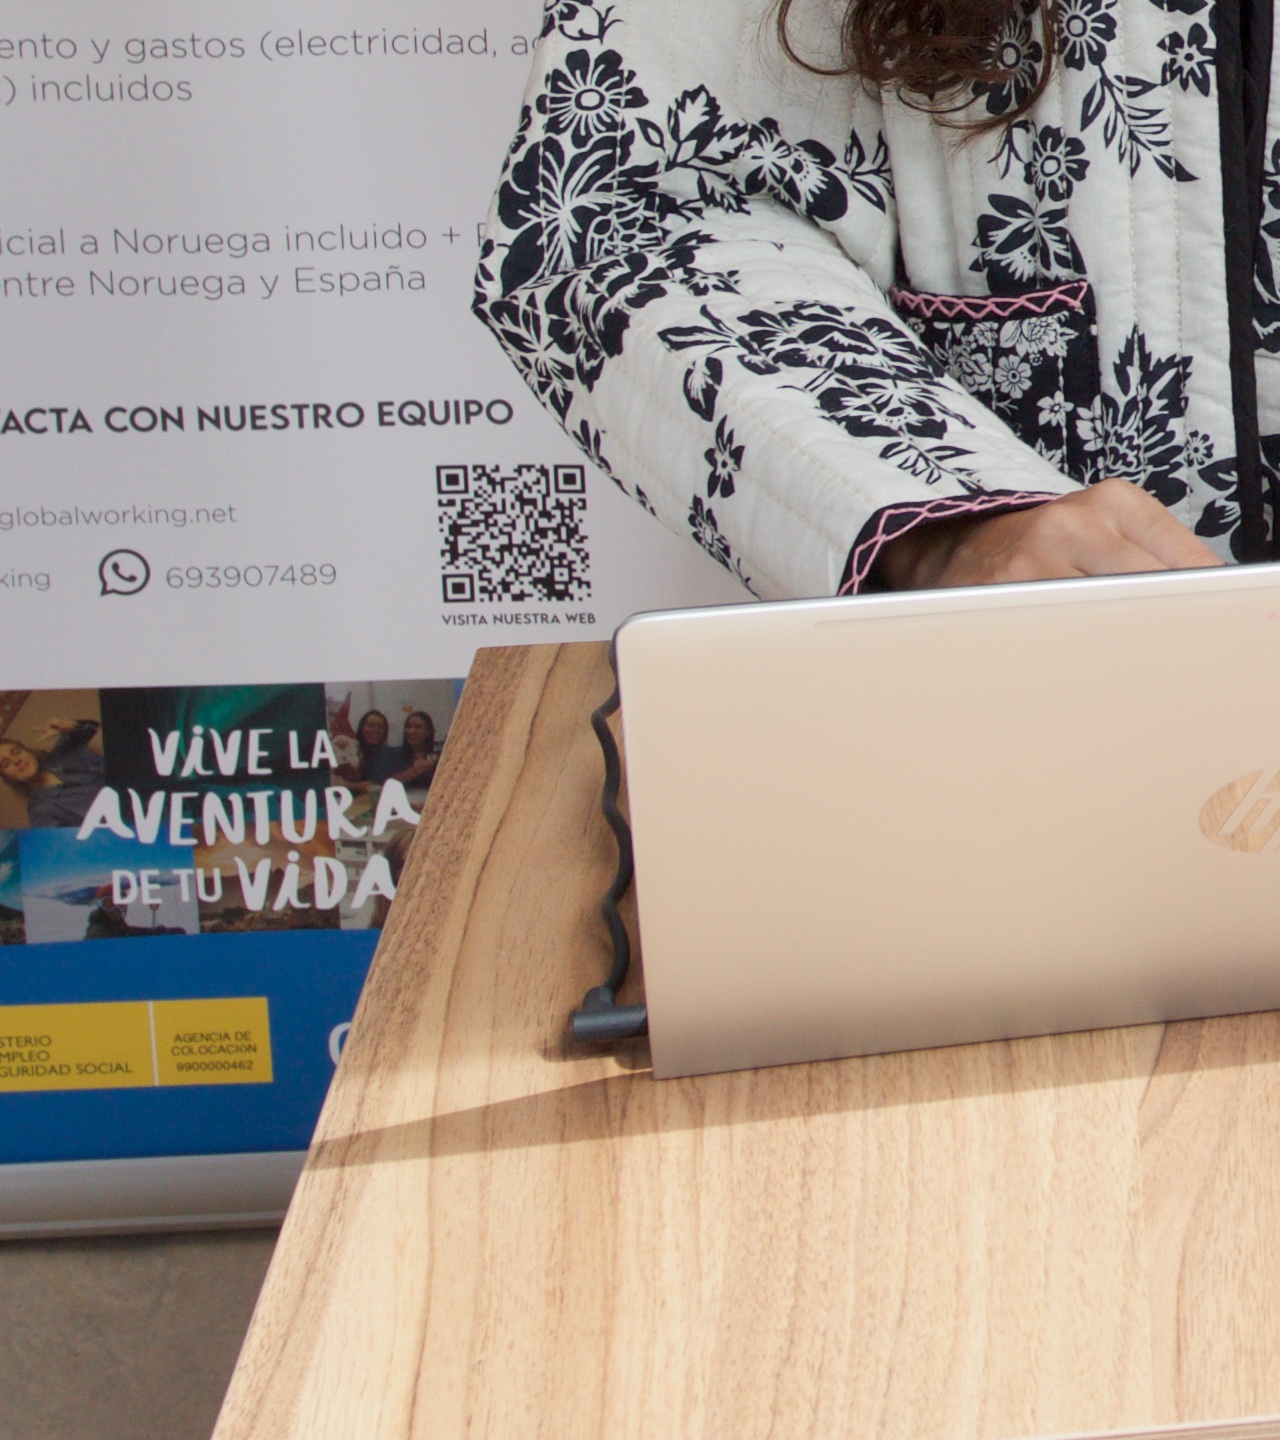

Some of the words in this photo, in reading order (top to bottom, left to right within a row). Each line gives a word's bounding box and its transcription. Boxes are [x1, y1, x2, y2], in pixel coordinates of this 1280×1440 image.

[91, 38, 111, 65] y
[124, 32, 246, 66] gastos
[259, 27, 499, 63] (electricidad,
[30, 72, 194, 103] incluidos
[79, 234, 99, 256] a
[113, 227, 271, 259] Noruega
[285, 221, 428, 252] incluido
[441, 226, 461, 245] +
[0, 268, 76, 298] ntre
[89, 269, 246, 301] Noruega
[259, 272, 279, 300] y
[295, 264, 427, 297] España
[0, 407, 93, 435] ACTA
[104, 405, 186, 433] CON
[197, 401, 365, 432] NUESTRO
[377, 398, 514, 429] EQUIPO
[0, 503, 238, 532] globalworking.net
[165, 563, 338, 590] 693907489
[441, 613, 488, 626] VISITA
[493, 612, 561, 625] NUESTRA
[565, 611, 597, 625] WEB
[288, 729, 339, 770] LA
[76, 776, 422, 848] AVENTURA
[110, 864, 165, 908] DE
[174, 867, 223, 904] TU
[173, 1031, 232, 1044] AGENCIA
[234, 1030, 253, 1043] DE
[76, 1061, 133, 1076] SOCIAL
